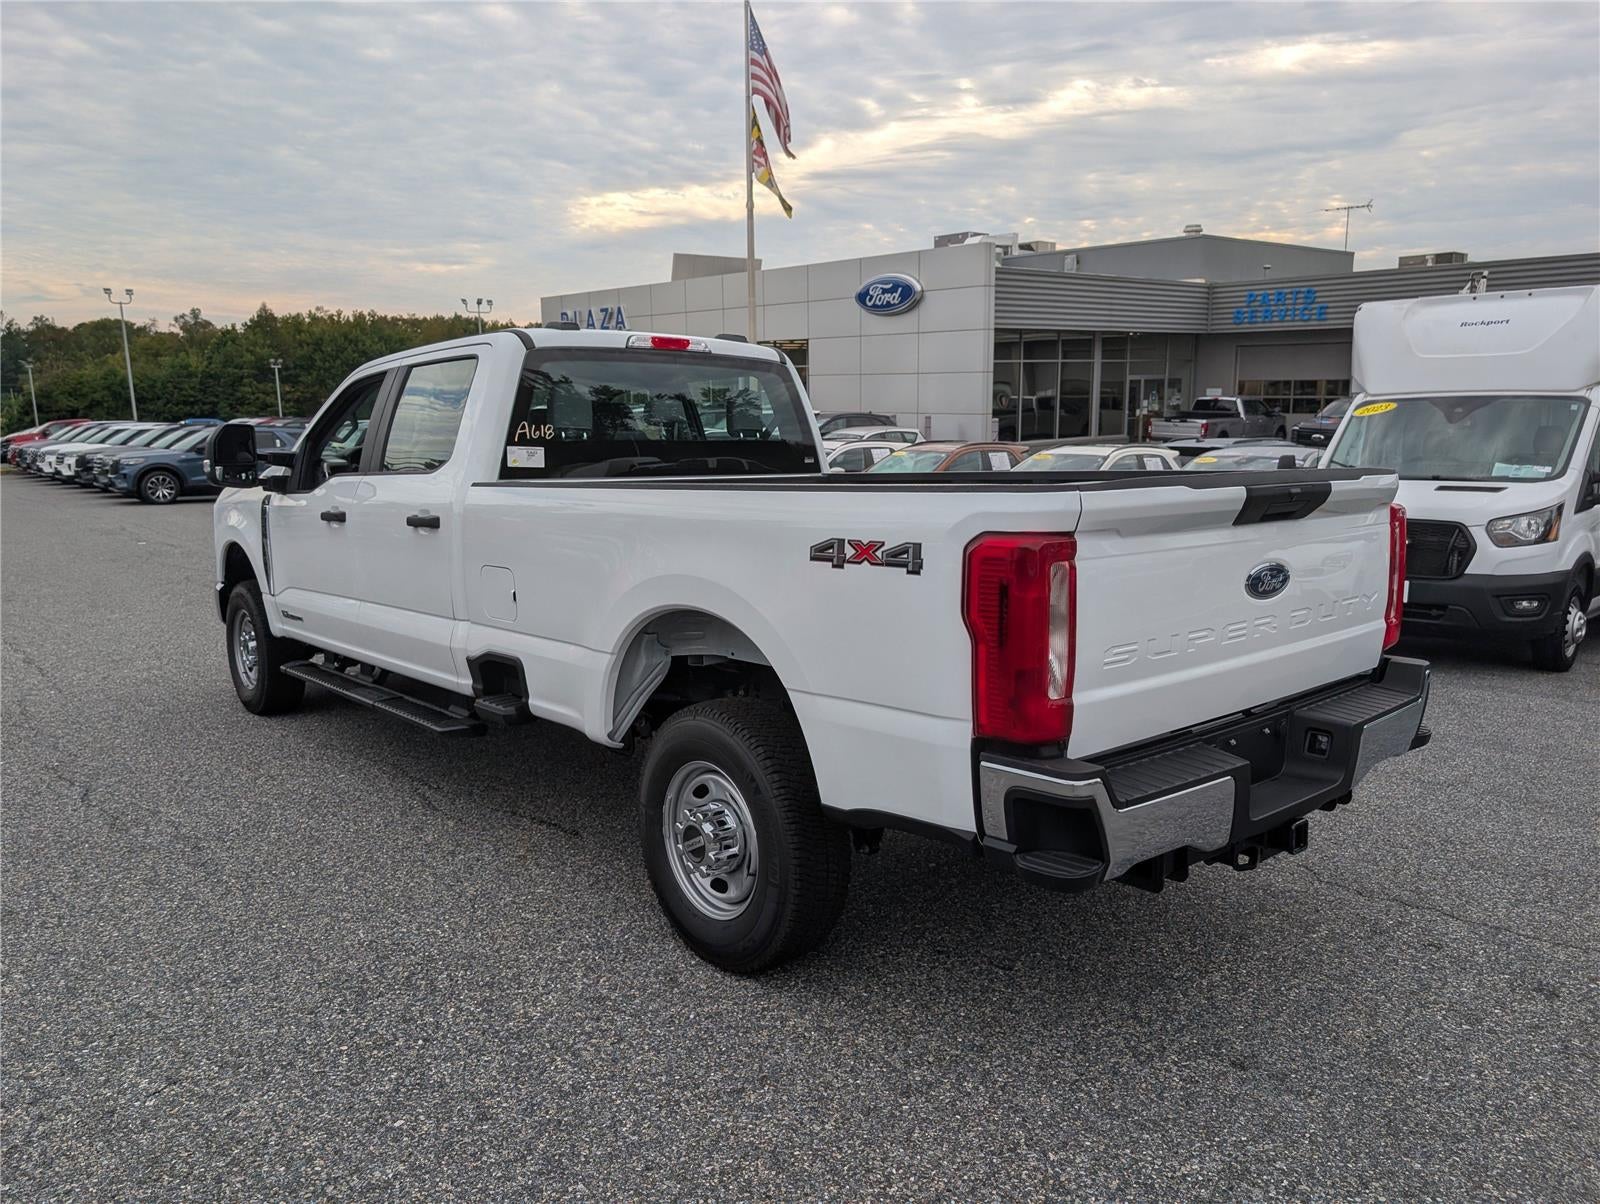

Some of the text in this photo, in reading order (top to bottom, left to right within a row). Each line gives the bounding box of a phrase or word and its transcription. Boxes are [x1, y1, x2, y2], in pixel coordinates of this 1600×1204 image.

[866, 283, 902, 307] Ford
[1245, 287, 1317, 305] PARTS
[1232, 303, 1329, 325] SERVICE
[1459, 319, 1511, 328] Rockport
[1358, 403, 1393, 415] 2023
[514, 421, 555, 442] A618
[1258, 570, 1284, 593] Ford
[1103, 591, 1379, 670] SUPER DUTY
